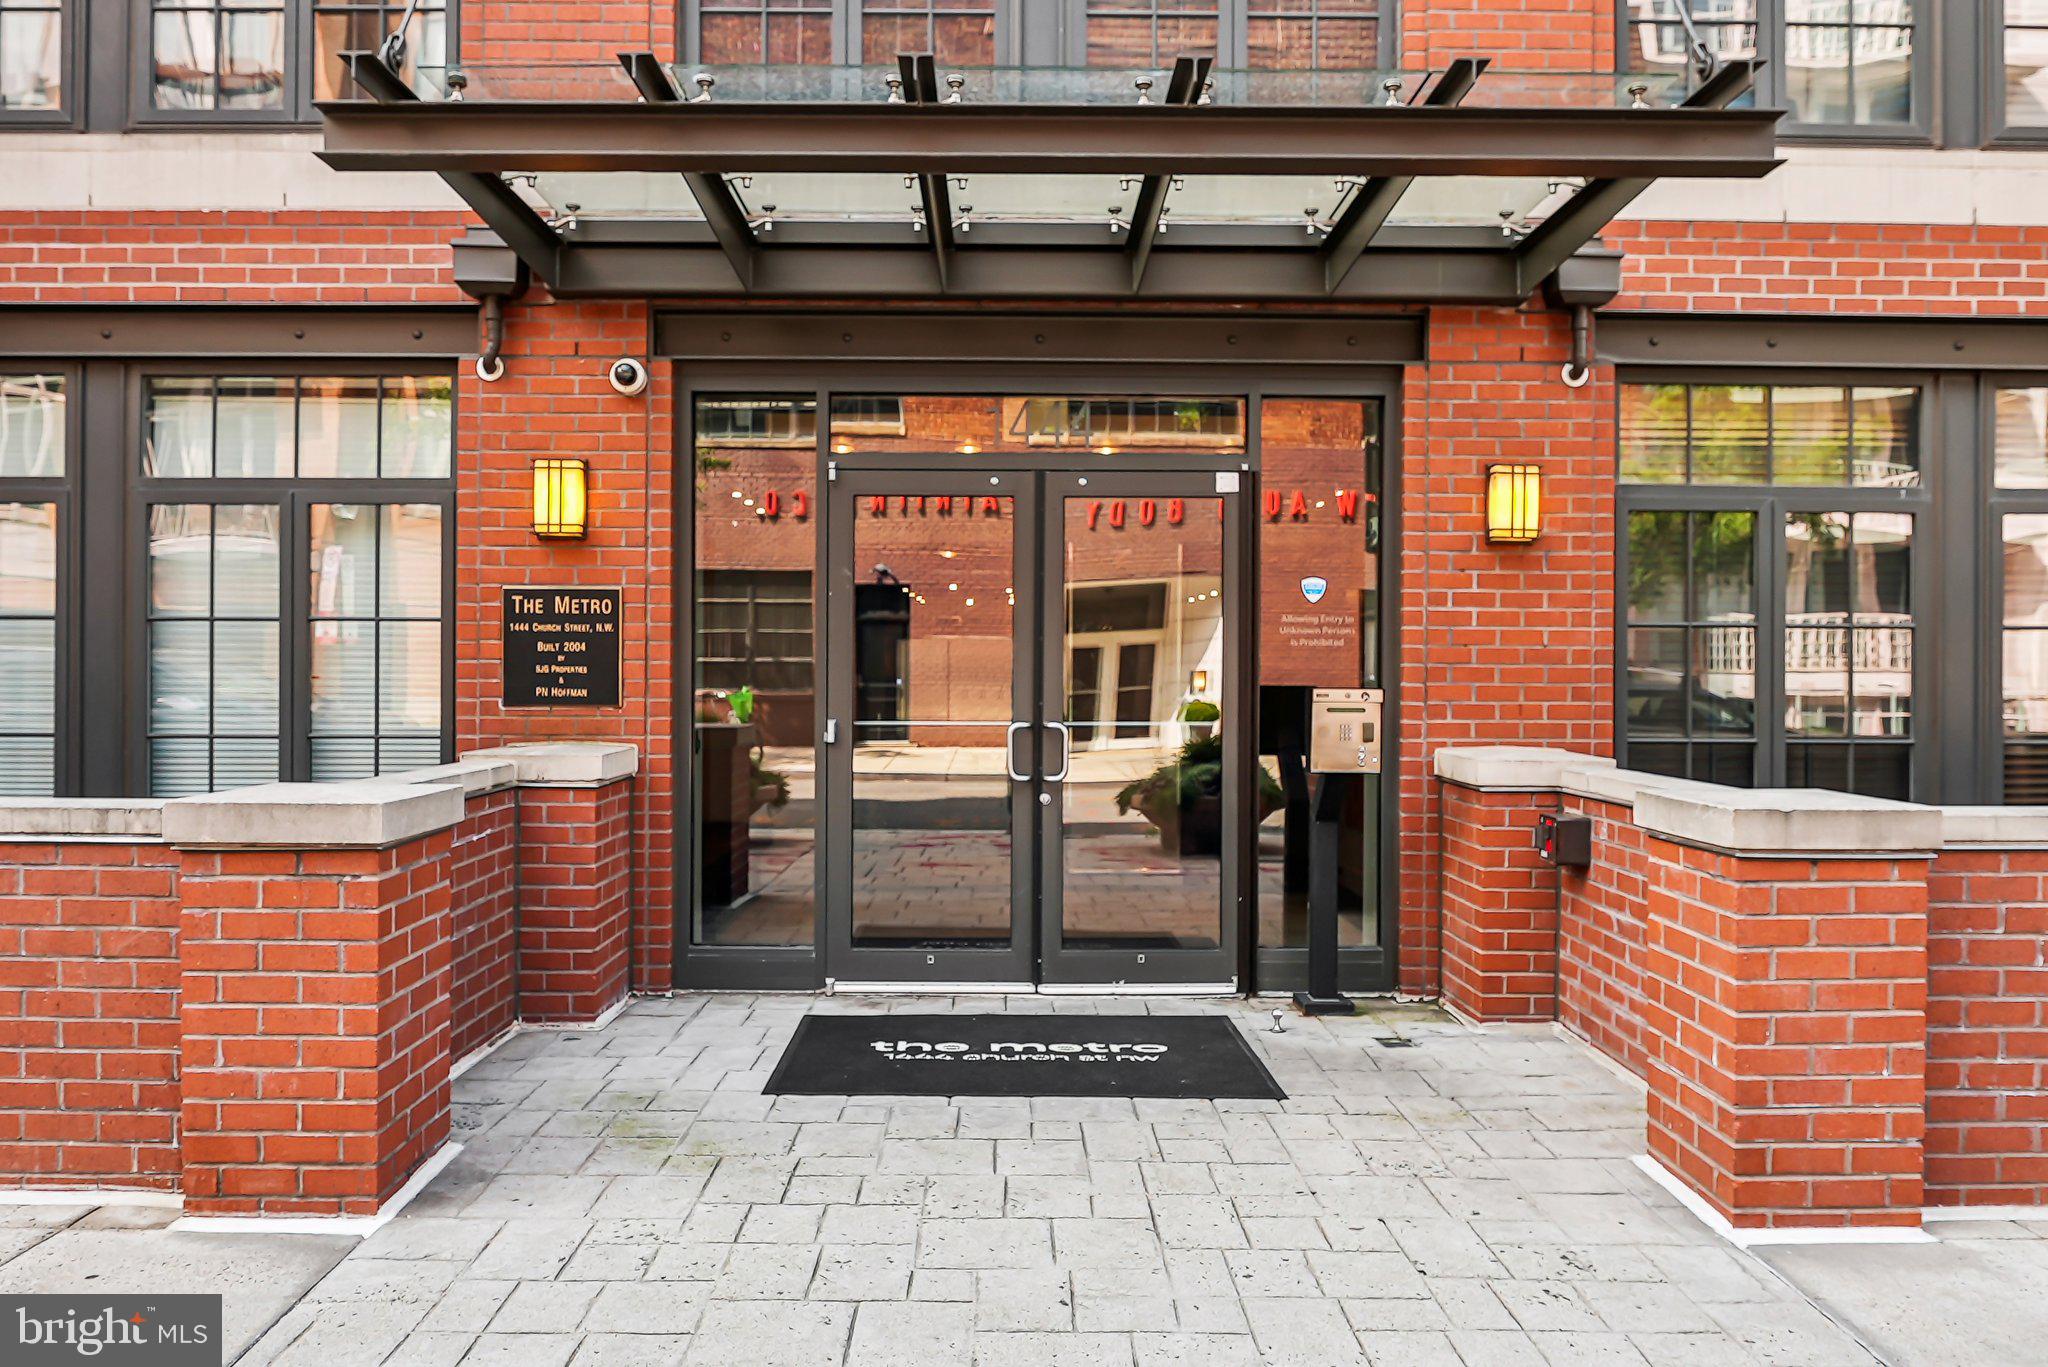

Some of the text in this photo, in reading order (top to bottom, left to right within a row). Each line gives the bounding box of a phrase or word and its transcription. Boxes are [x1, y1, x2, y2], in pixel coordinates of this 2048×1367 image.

[983, 397, 1093, 448] 1444
[511, 595, 612, 615] THE METRO
[510, 622, 529, 632] 1444
[595, 623, 615, 632] N.W.
[537, 641, 586, 652] BUILT 2004
[535, 686, 588, 697] PN HOFFMAN
[870, 1040, 1168, 1053] the metro
[883, 1053, 955, 1062] 1444
